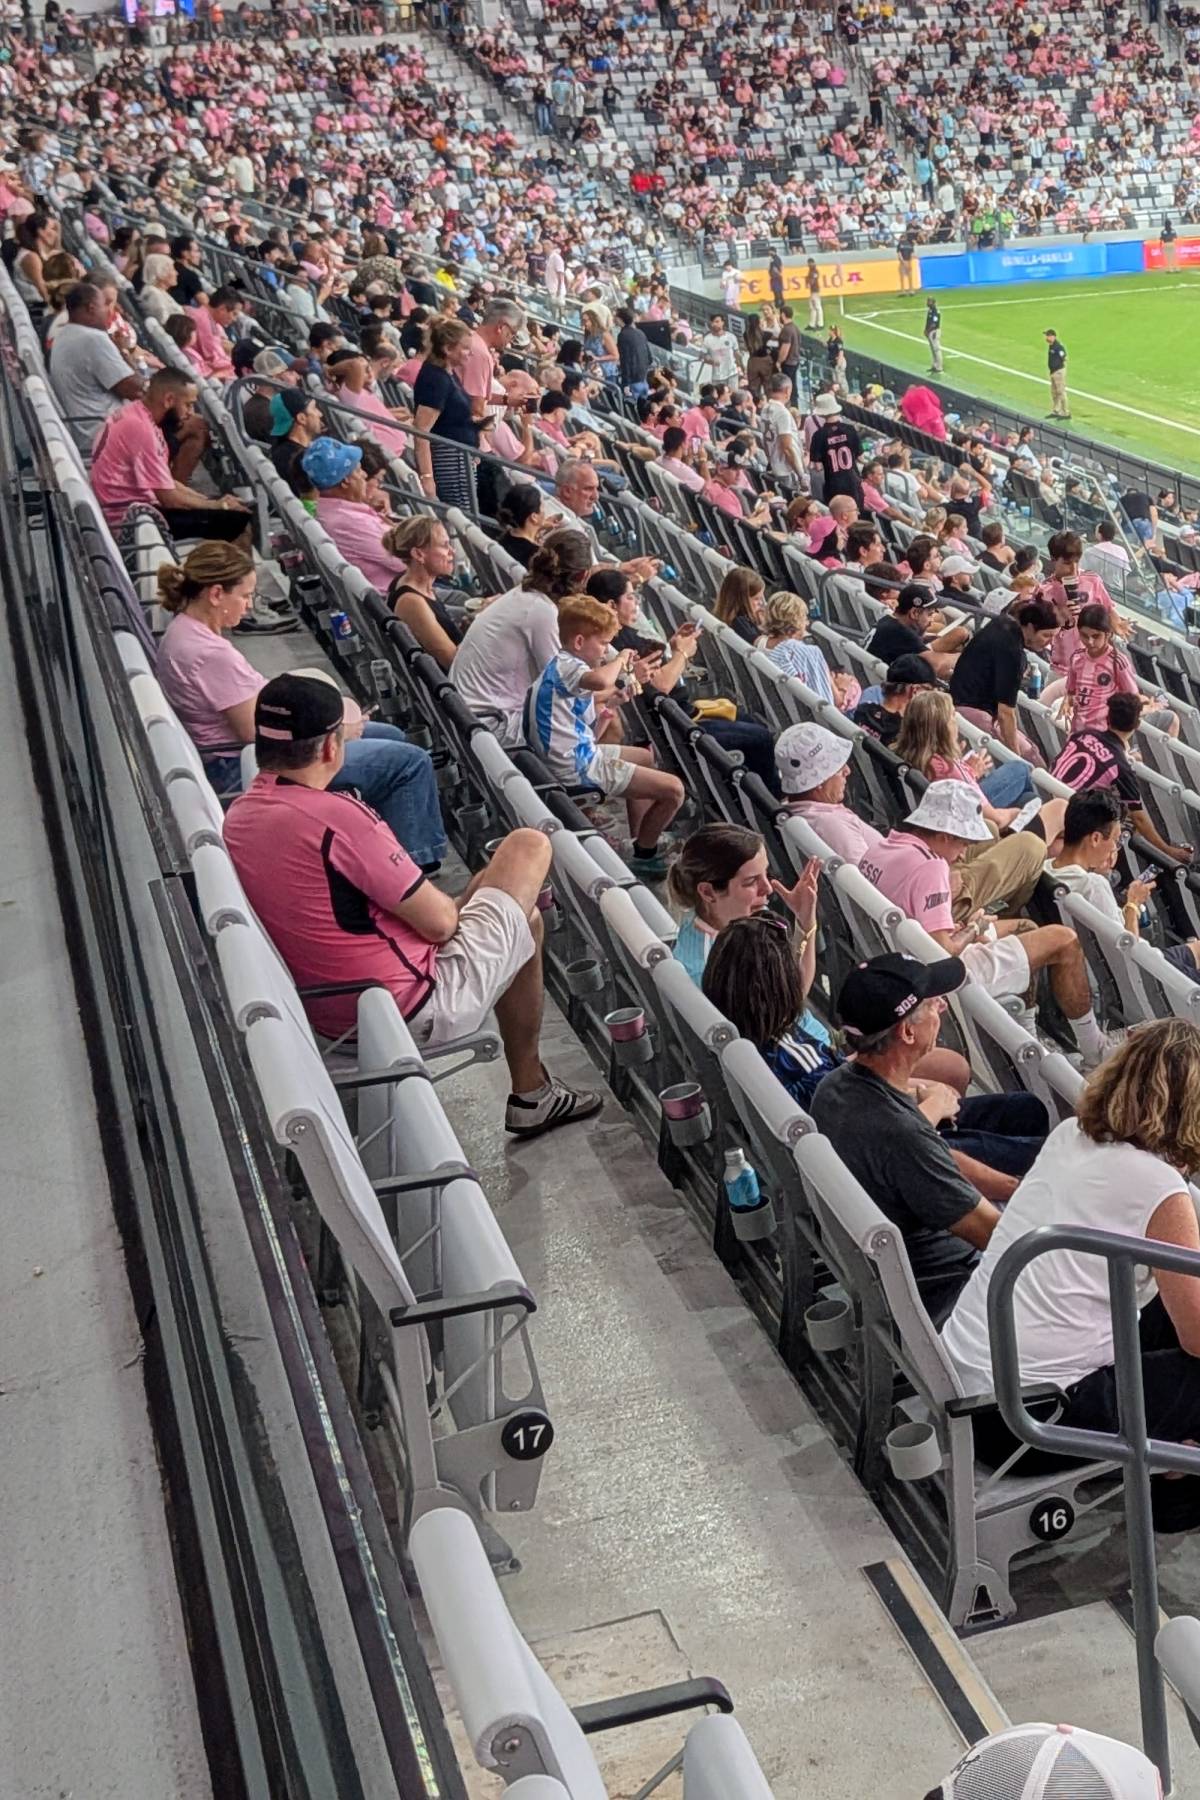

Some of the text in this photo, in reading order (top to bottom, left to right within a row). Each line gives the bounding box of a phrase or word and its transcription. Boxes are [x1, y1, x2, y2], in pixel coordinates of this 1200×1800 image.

[780, 270, 844, 292] USTLO
[827, 445, 853, 473] 10
[1051, 740, 1096, 791] 10
[859, 859, 884, 885] ESSI
[894, 993, 918, 1017] 305
[513, 1424, 546, 1450] 17
[1039, 1508, 1067, 1533] 16
